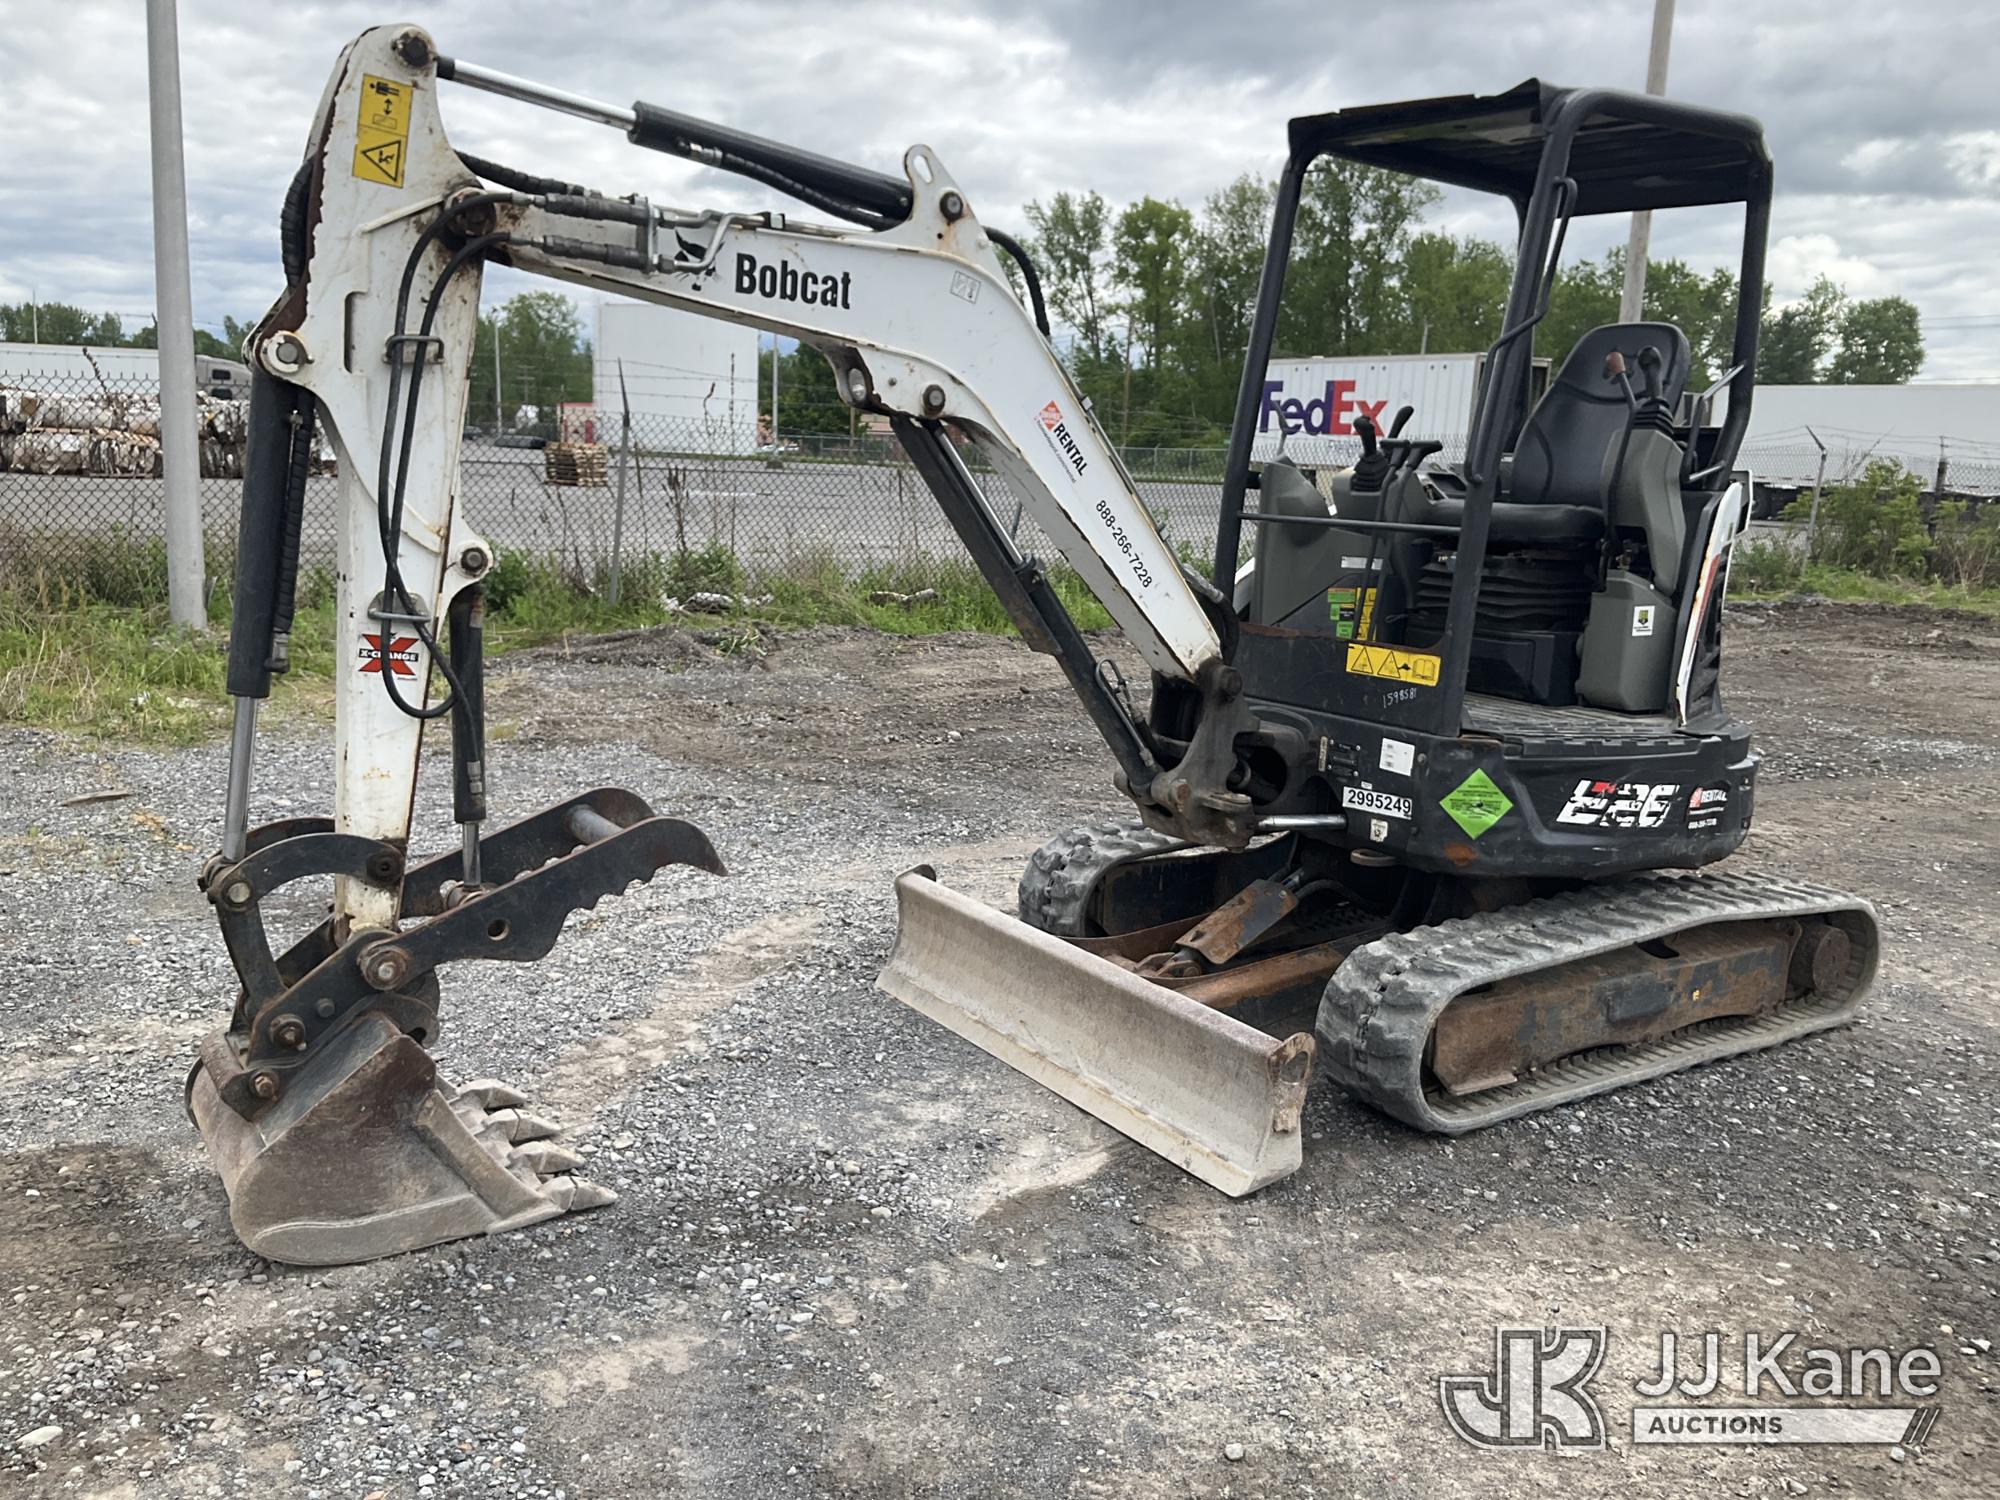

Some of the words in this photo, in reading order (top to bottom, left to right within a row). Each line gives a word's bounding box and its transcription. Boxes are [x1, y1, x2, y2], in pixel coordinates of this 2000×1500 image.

[735, 252, 852, 310] Bobcat
[1259, 380, 1388, 437] FedEx
[1053, 422, 1088, 477] RENTAL
[1096, 500, 1152, 588] 888-266-7228
[1348, 789, 1411, 814] 2995249
